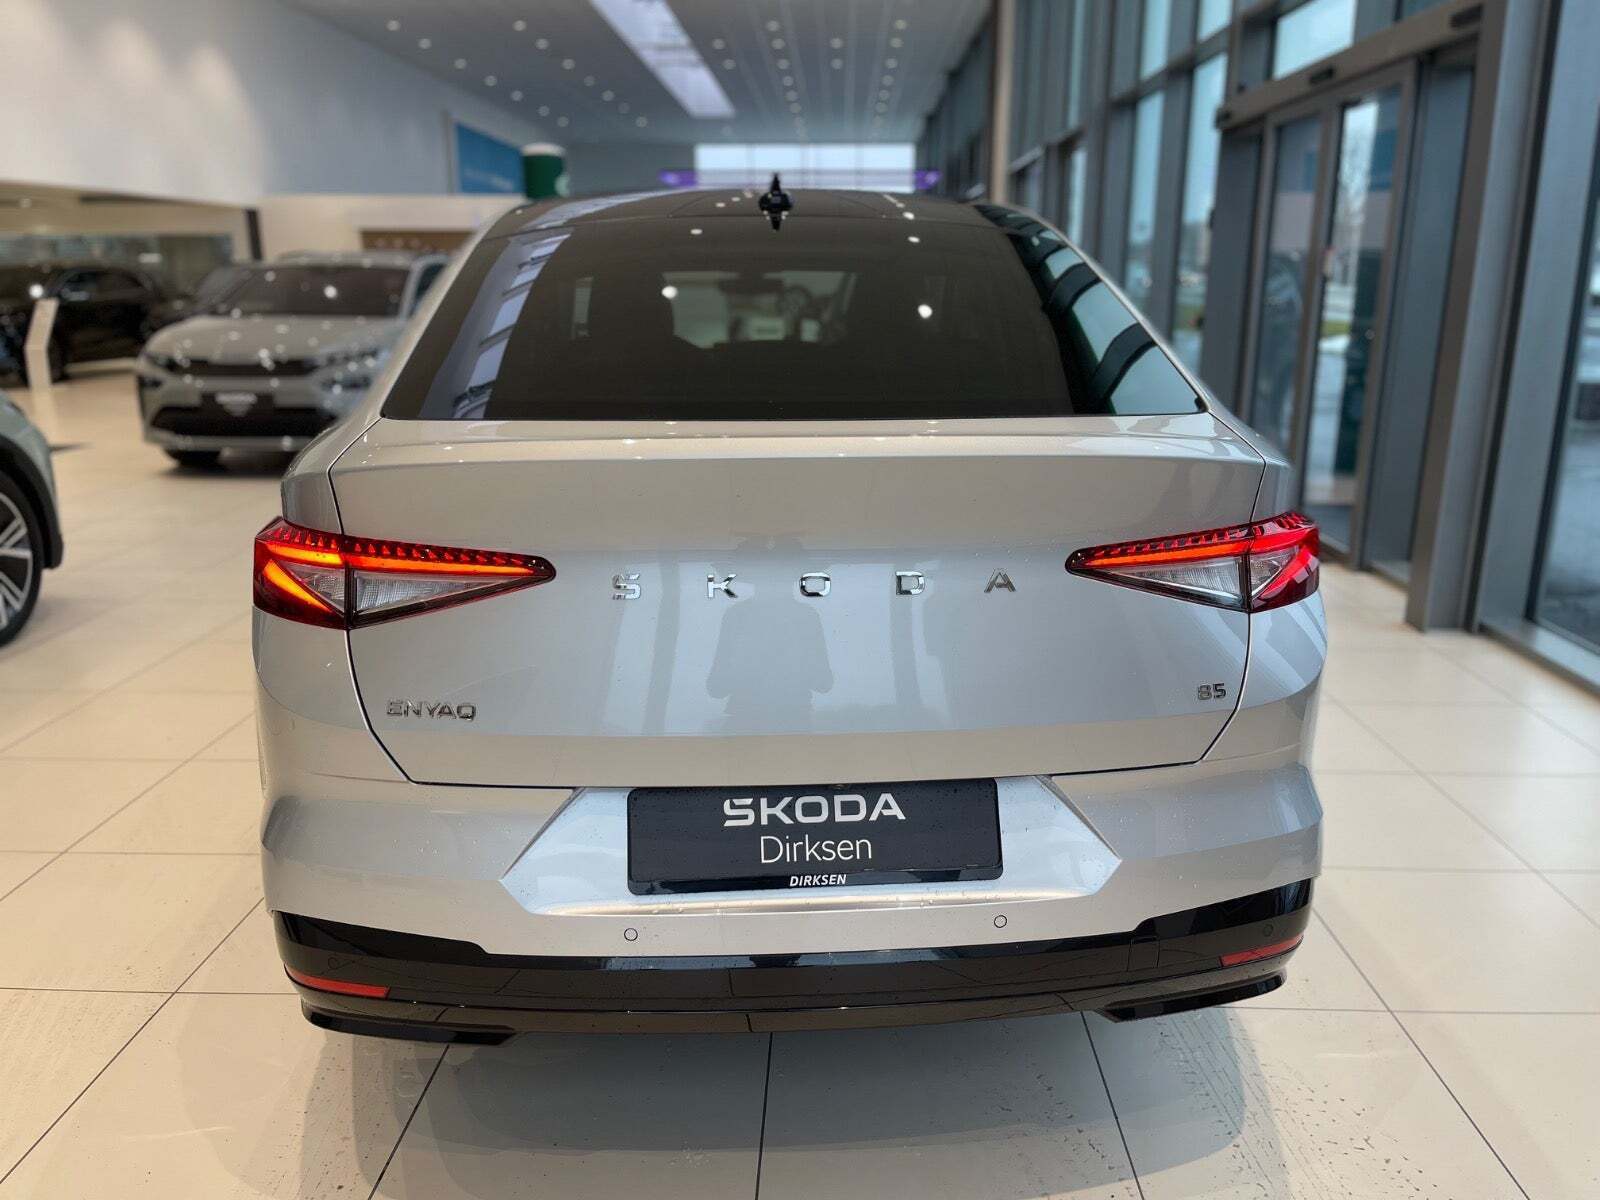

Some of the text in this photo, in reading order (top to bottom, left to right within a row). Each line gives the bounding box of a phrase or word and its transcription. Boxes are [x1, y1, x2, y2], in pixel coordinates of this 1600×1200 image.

[612, 568, 1017, 600] SKODA
[1197, 682, 1227, 701] 85
[386, 700, 477, 721] ENYAQ
[723, 792, 906, 827] SKODA
[760, 834, 872, 864] Dirksen
[789, 873, 847, 888] DIRKSEN
